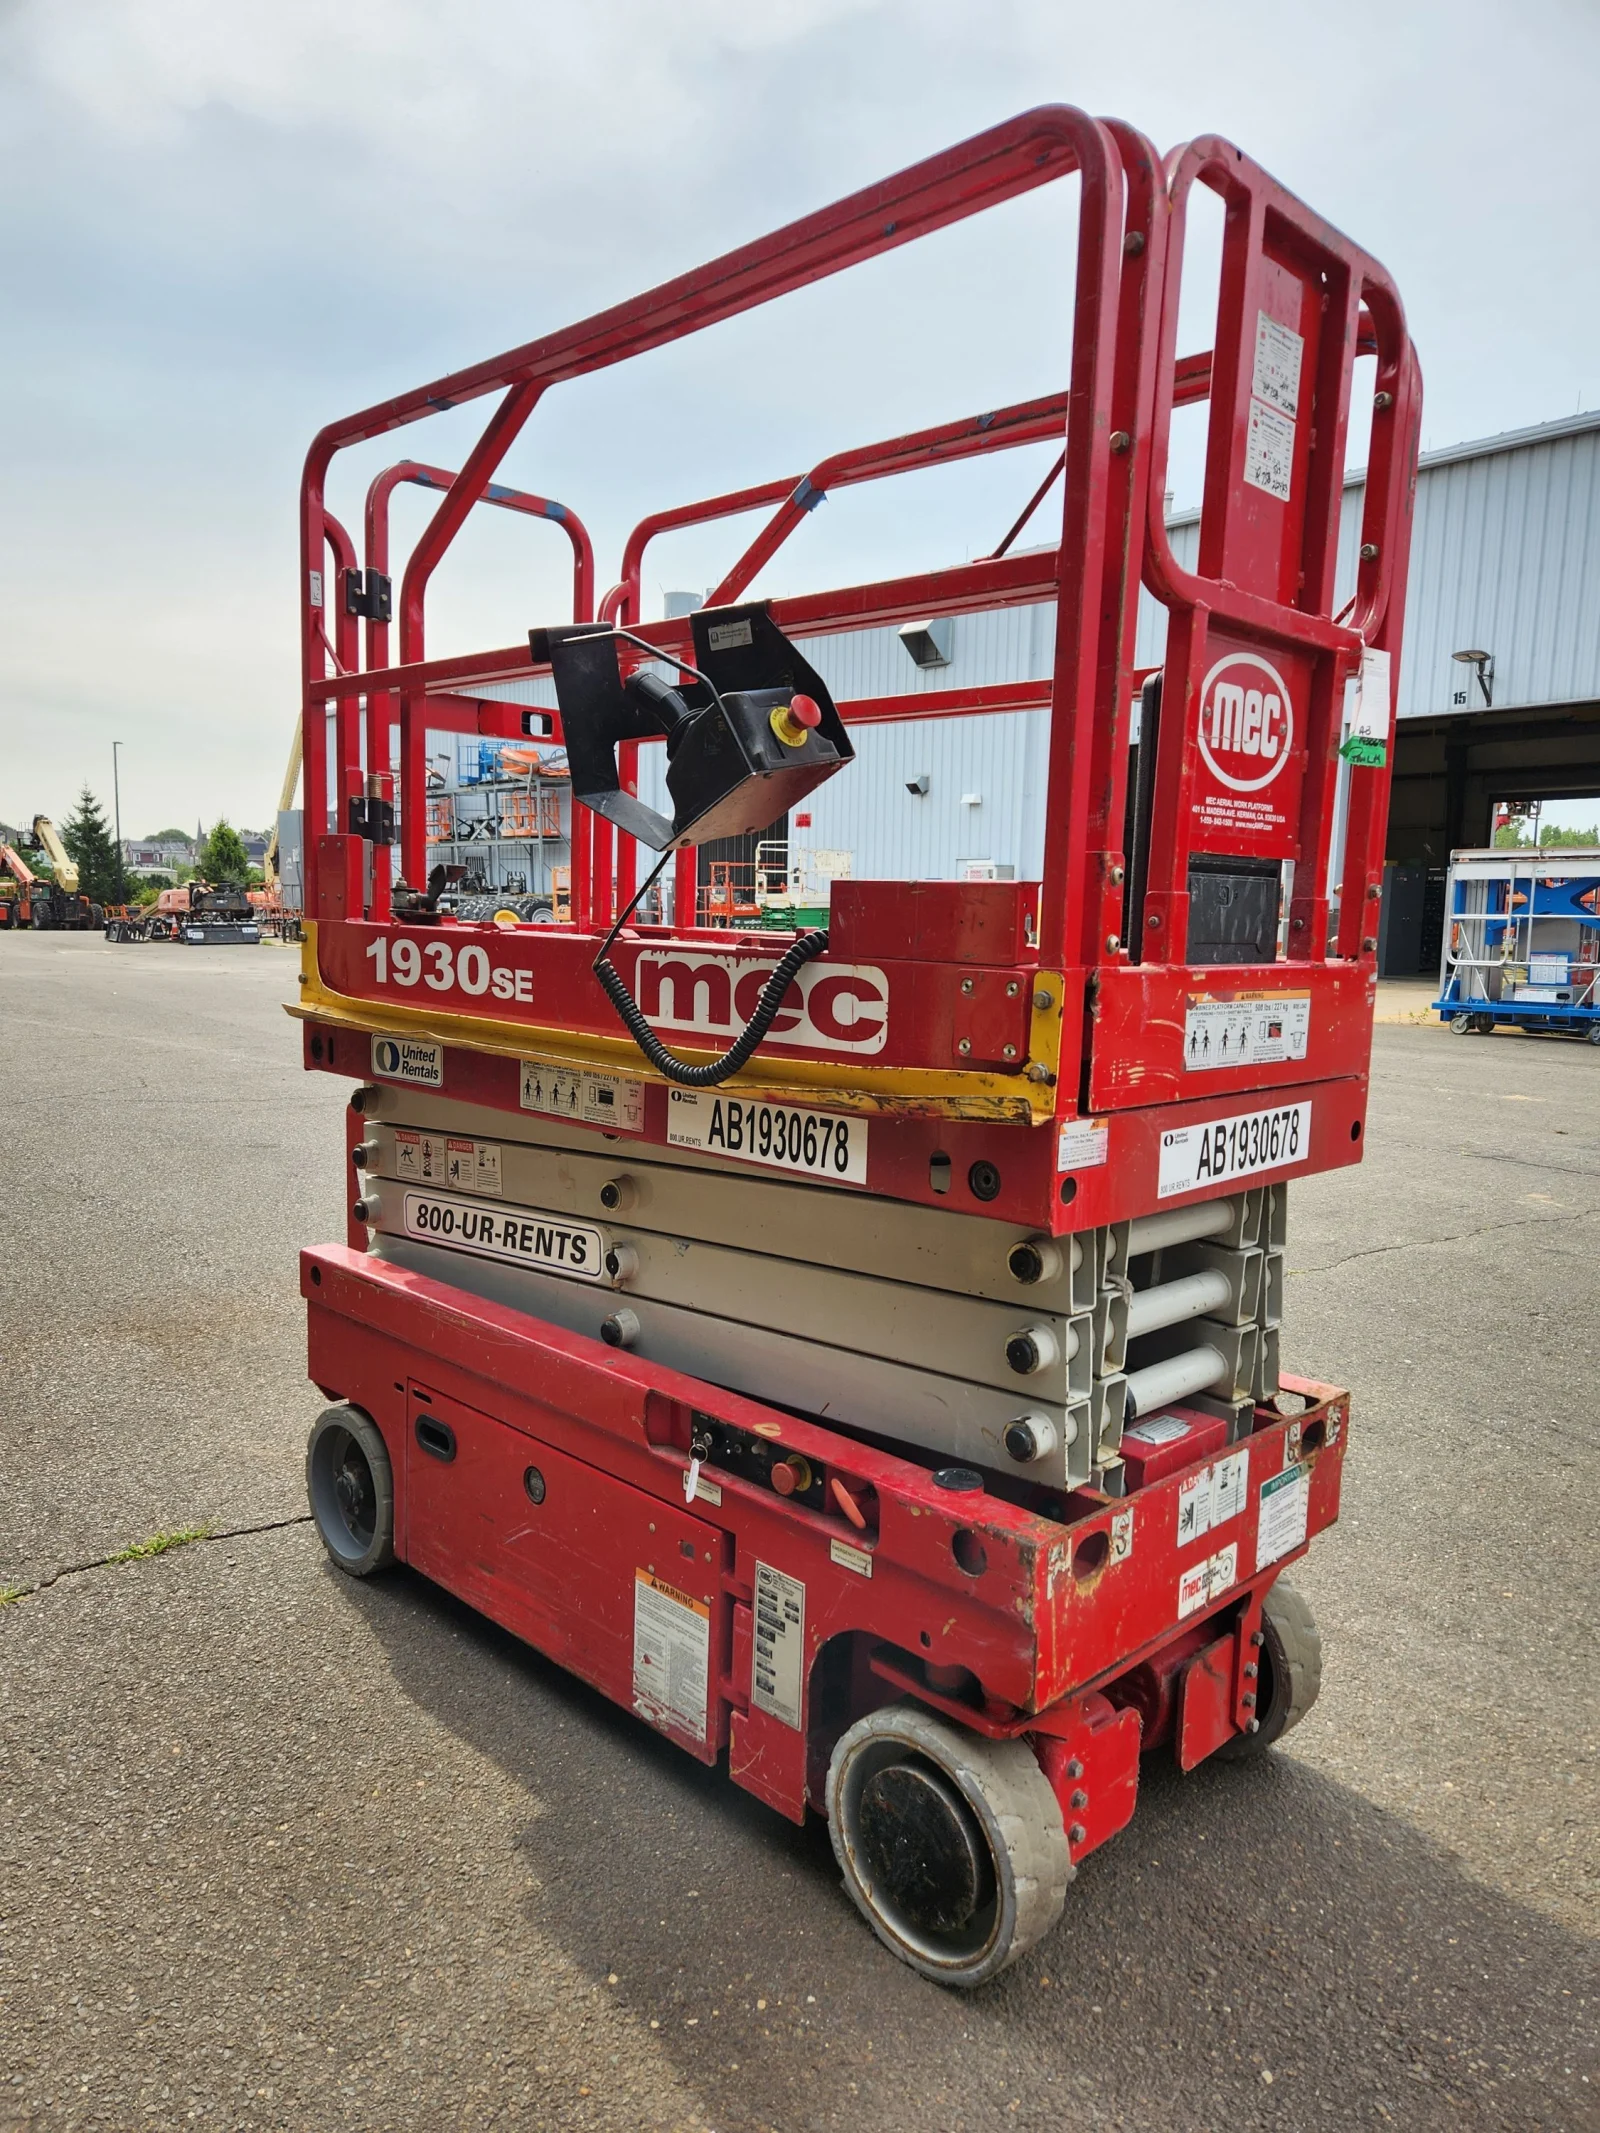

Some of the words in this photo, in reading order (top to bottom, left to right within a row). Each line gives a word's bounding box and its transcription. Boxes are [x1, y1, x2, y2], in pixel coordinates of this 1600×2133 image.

[1453, 691, 1467, 705] 15
[1210, 681, 1280, 759] mec
[640, 959, 884, 1043] mec
[1211, 1003, 1232, 1011] PLATFORM
[1233, 1002, 1252, 1010] CAPACITY
[402, 1044, 436, 1063] United
[401, 1060, 439, 1080] Rentals
[682, 1091, 697, 1101] United
[401, 1132, 419, 1143] DANGER
[452, 1142, 473, 1152] DANGER
[708, 1099, 849, 1173] AB1930678
[1196, 1108, 1299, 1181] AB1930678
[416, 1203, 587, 1265] 800-UR-RENTS
[1270, 1468, 1298, 1492] IMPORTAN
[658, 1580, 695, 1609] WARNING
